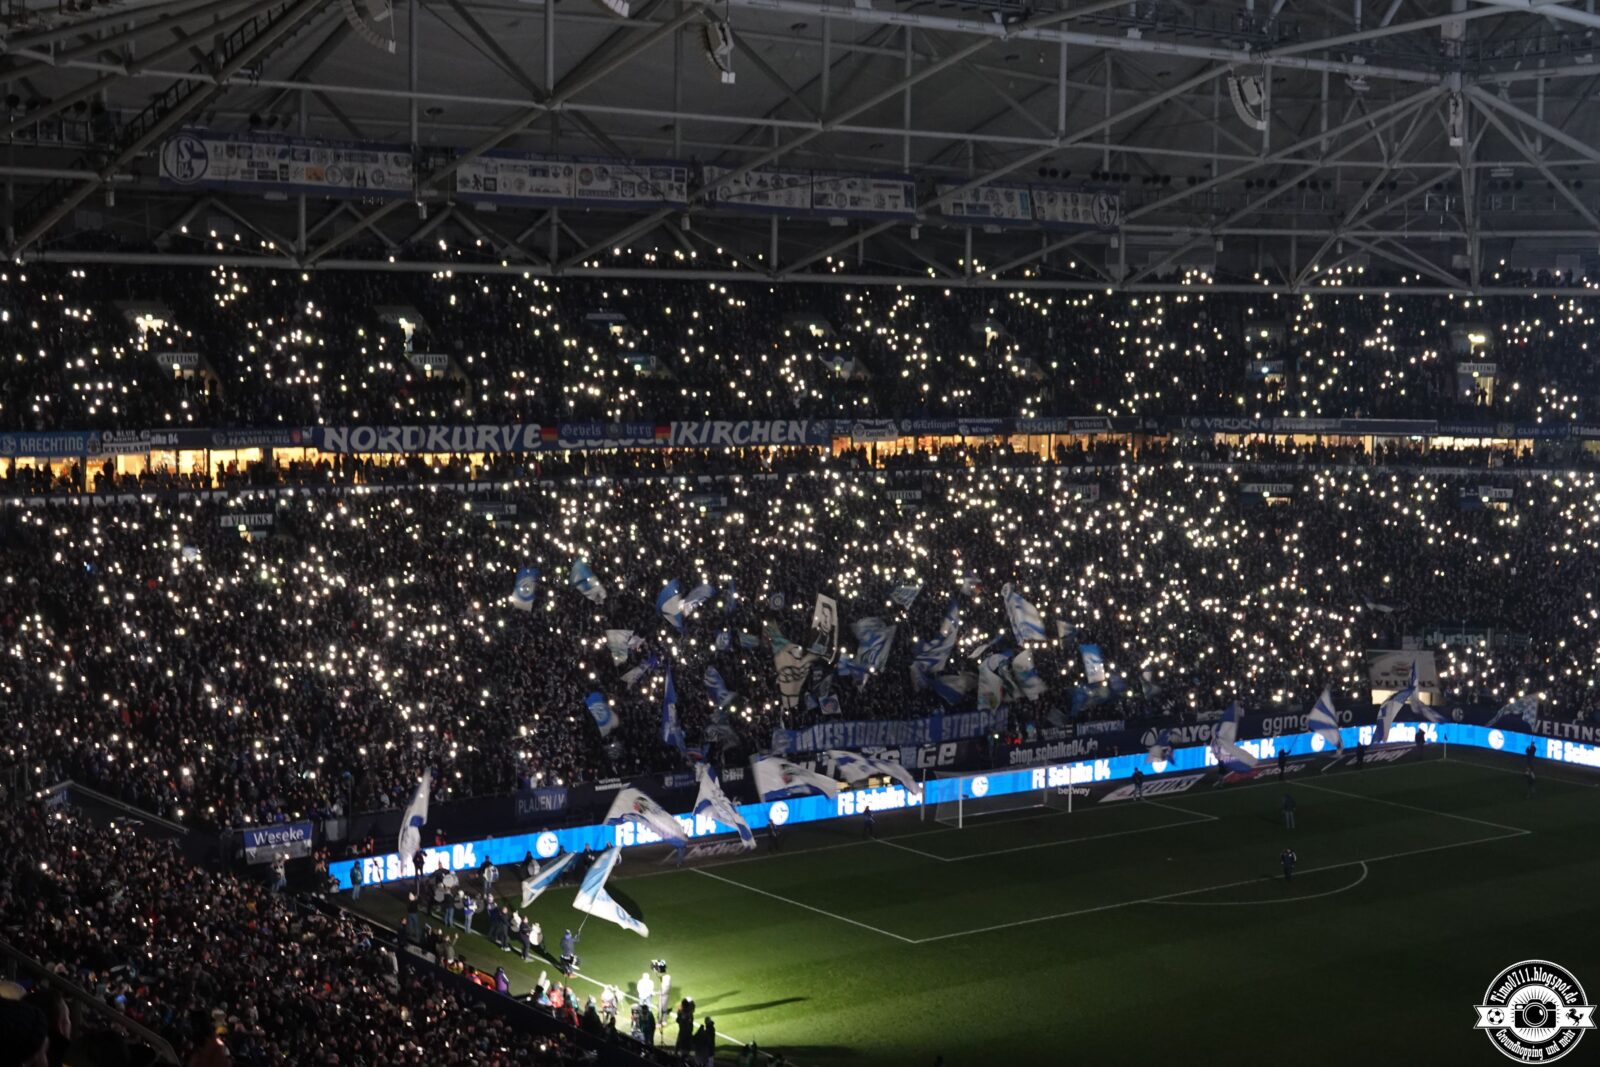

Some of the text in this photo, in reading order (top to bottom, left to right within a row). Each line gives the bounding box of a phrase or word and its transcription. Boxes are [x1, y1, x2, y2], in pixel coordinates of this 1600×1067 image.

[1204, 418, 1259, 430] VREDEN
[1516, 426, 1539, 435] CLUB
[20, 436, 84, 453] KRECHTING
[228, 435, 290, 446] HAMBURG
[323, 424, 542, 452] NORDKURVE
[1374, 680, 1434, 688] VELTNS
[1262, 709, 1353, 736] ggmgro
[1009, 737, 1099, 765] shop.schalke04.de
[1094, 759, 1111, 781] 04
[856, 787, 906, 813] Schalke
[253, 826, 304, 846] Weseke
[363, 856, 384, 884] FC
[453, 843, 476, 874] 04
